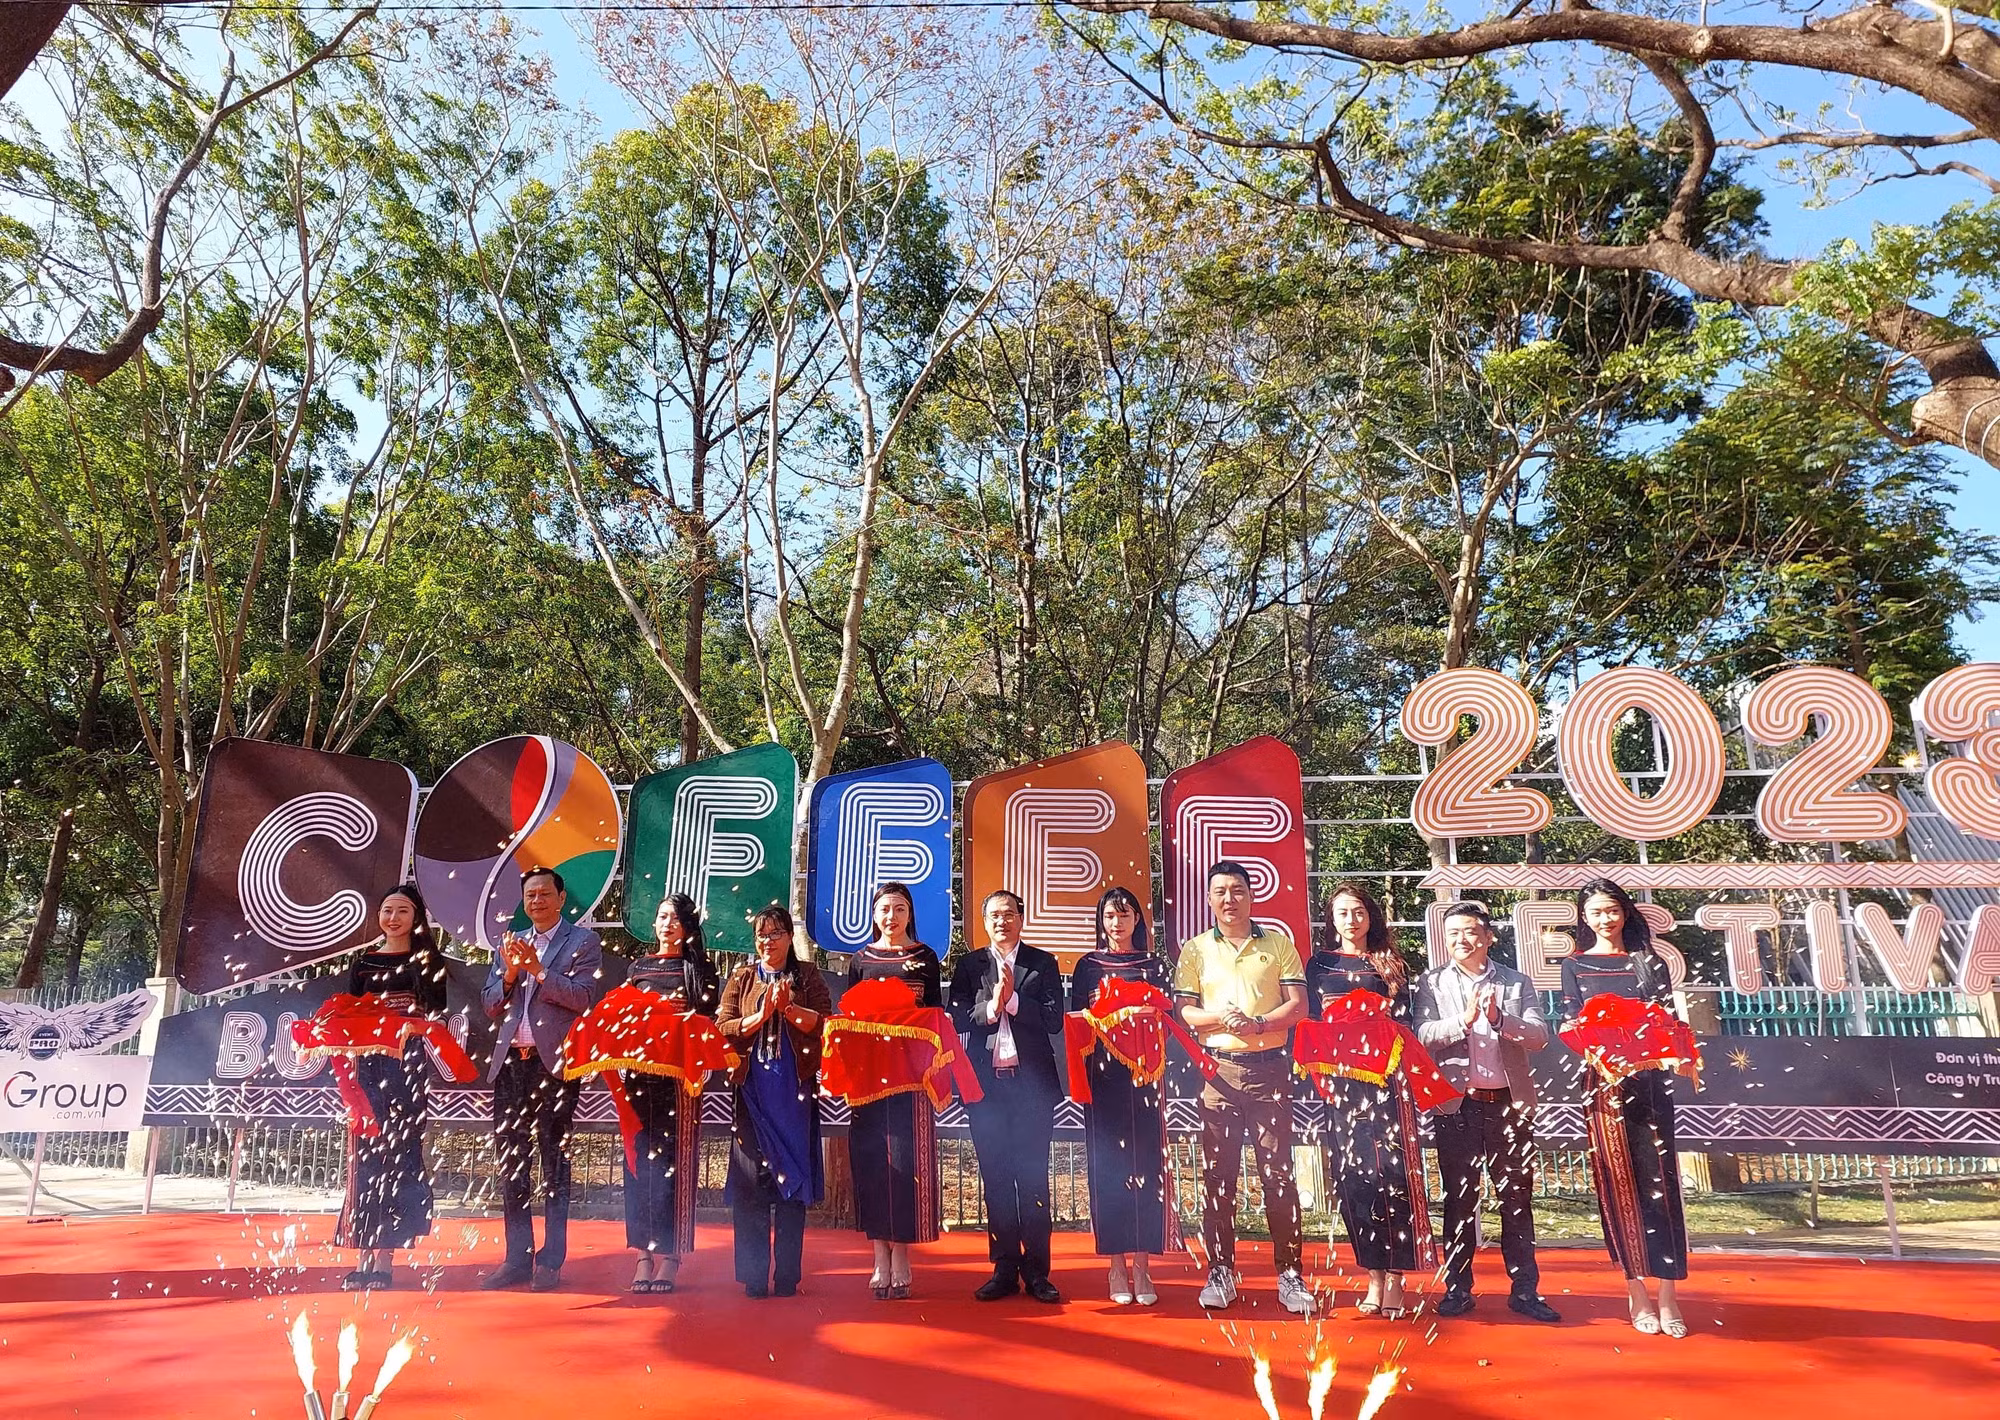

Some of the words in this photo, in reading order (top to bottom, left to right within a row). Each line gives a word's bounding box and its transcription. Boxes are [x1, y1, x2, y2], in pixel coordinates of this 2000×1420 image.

[1935, 1052, 1964, 1063] Đơn
[1967, 1053, 1980, 1067] vị
[1925, 1072, 1964, 1087] Công
[1967, 1073, 1980, 1087] ty
[4, 1071, 127, 1118] Group
